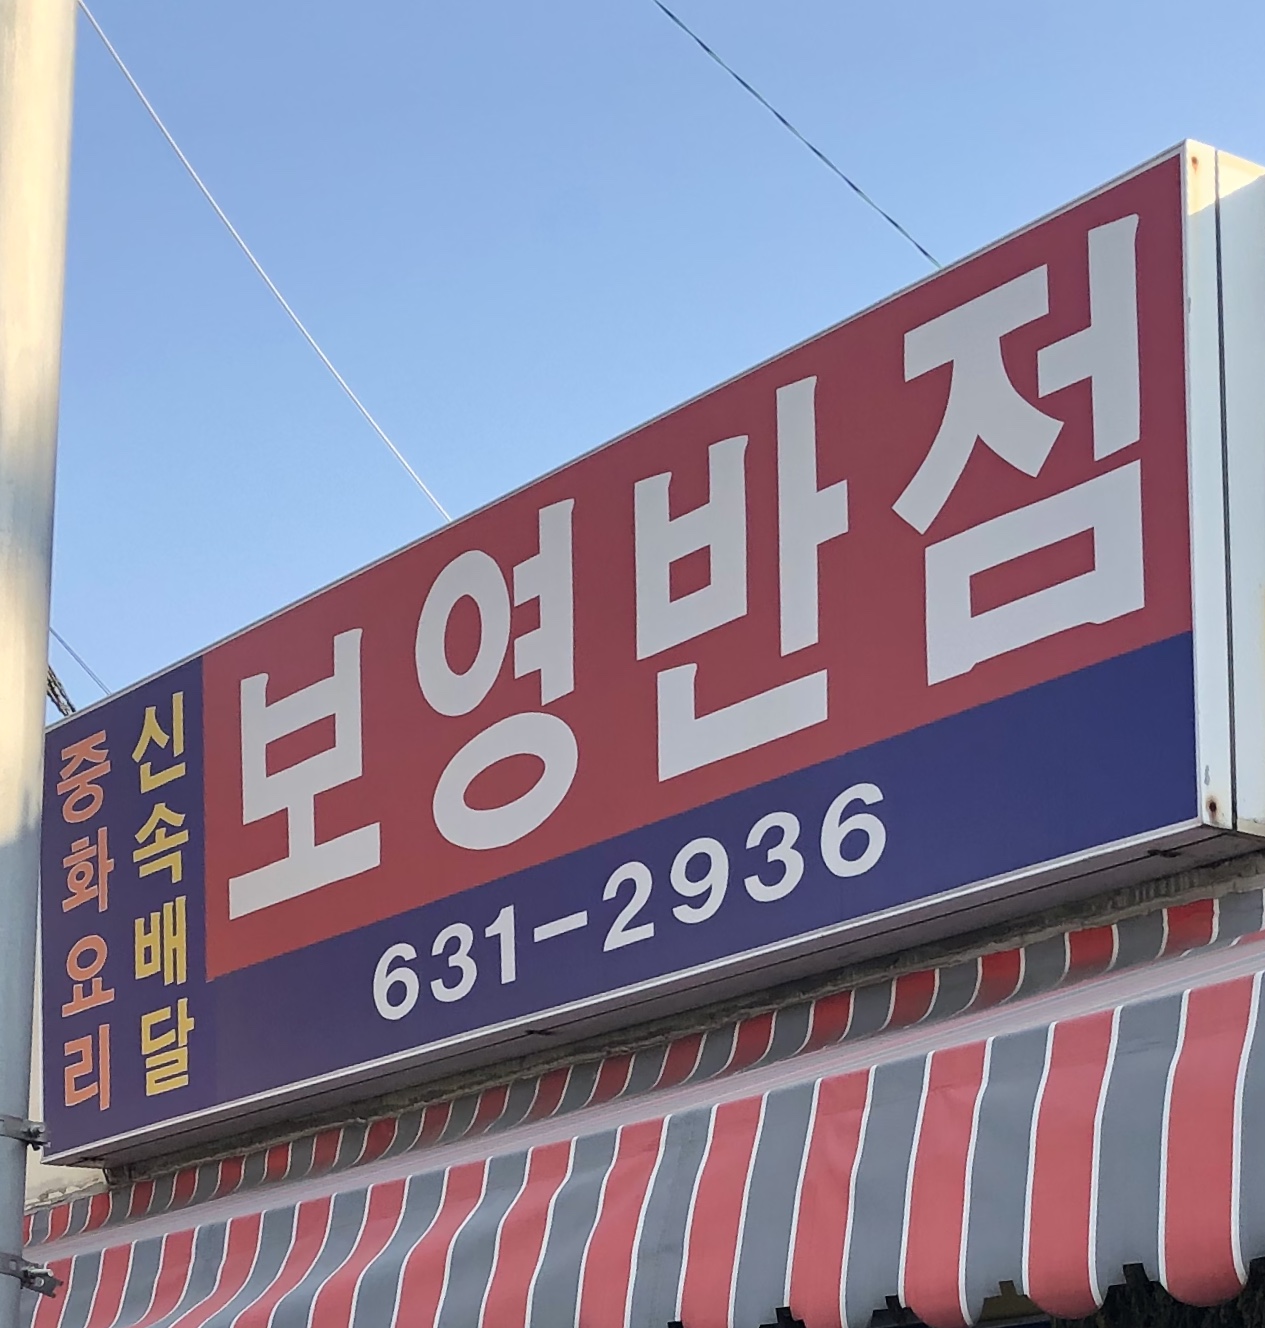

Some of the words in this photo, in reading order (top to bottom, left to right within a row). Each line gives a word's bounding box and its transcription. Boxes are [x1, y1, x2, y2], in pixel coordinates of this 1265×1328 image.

[229, 214, 1146, 920] 보영반점
[56, 730, 115, 1110] 중화요리
[131, 691, 195, 1097] 신속배달
[371, 781, 887, 1020] 631-2936
